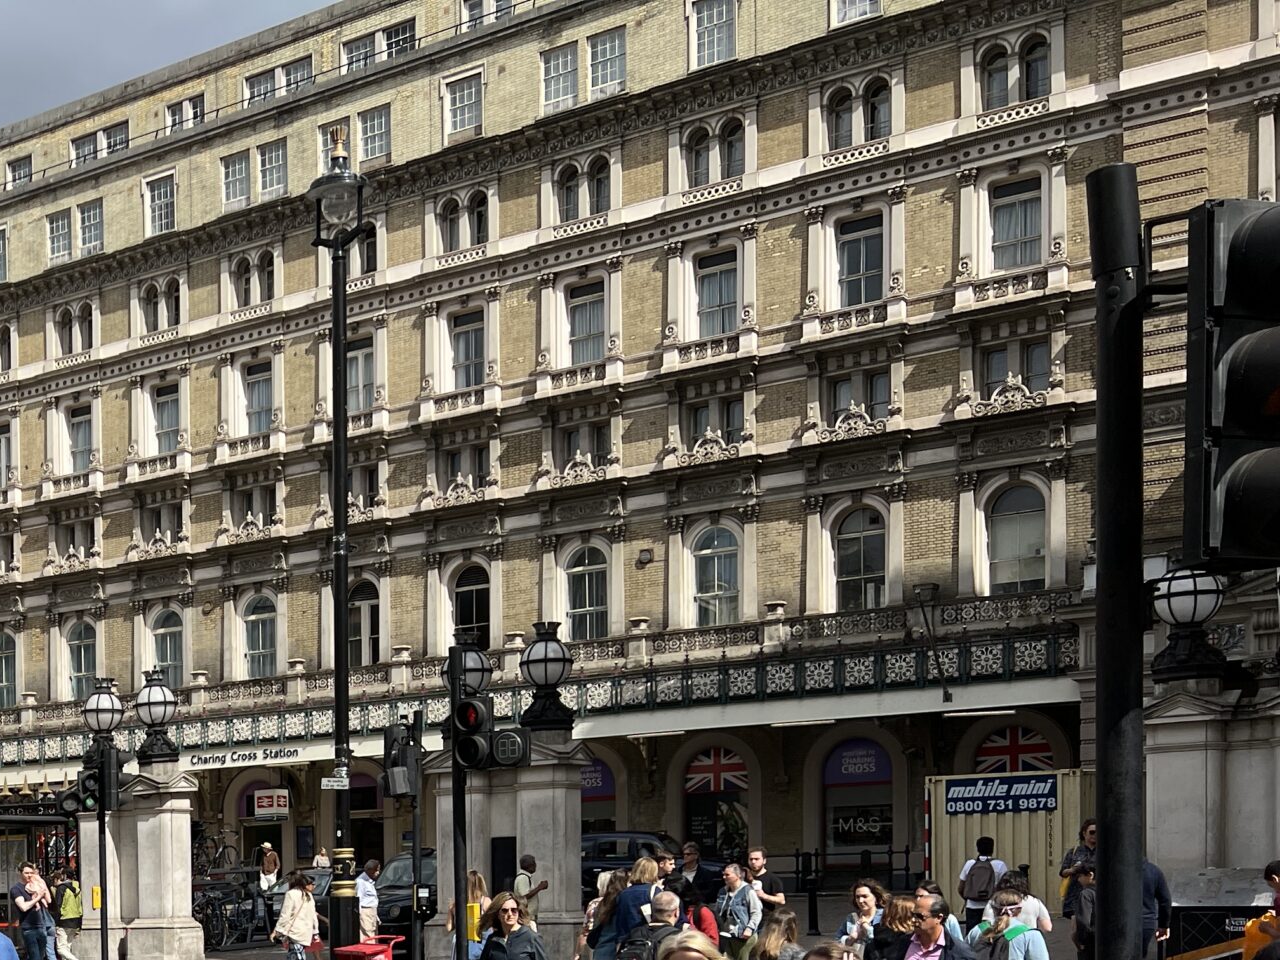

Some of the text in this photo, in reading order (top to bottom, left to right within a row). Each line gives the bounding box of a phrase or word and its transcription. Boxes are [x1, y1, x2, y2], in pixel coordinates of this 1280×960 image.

[191, 747, 299, 765] Charing Cross Station
[841, 763, 876, 774] CROSS
[947, 779, 1053, 798] mobile mini
[947, 797, 1057, 812] 0800 731 9878
[839, 817, 880, 833] M&S
